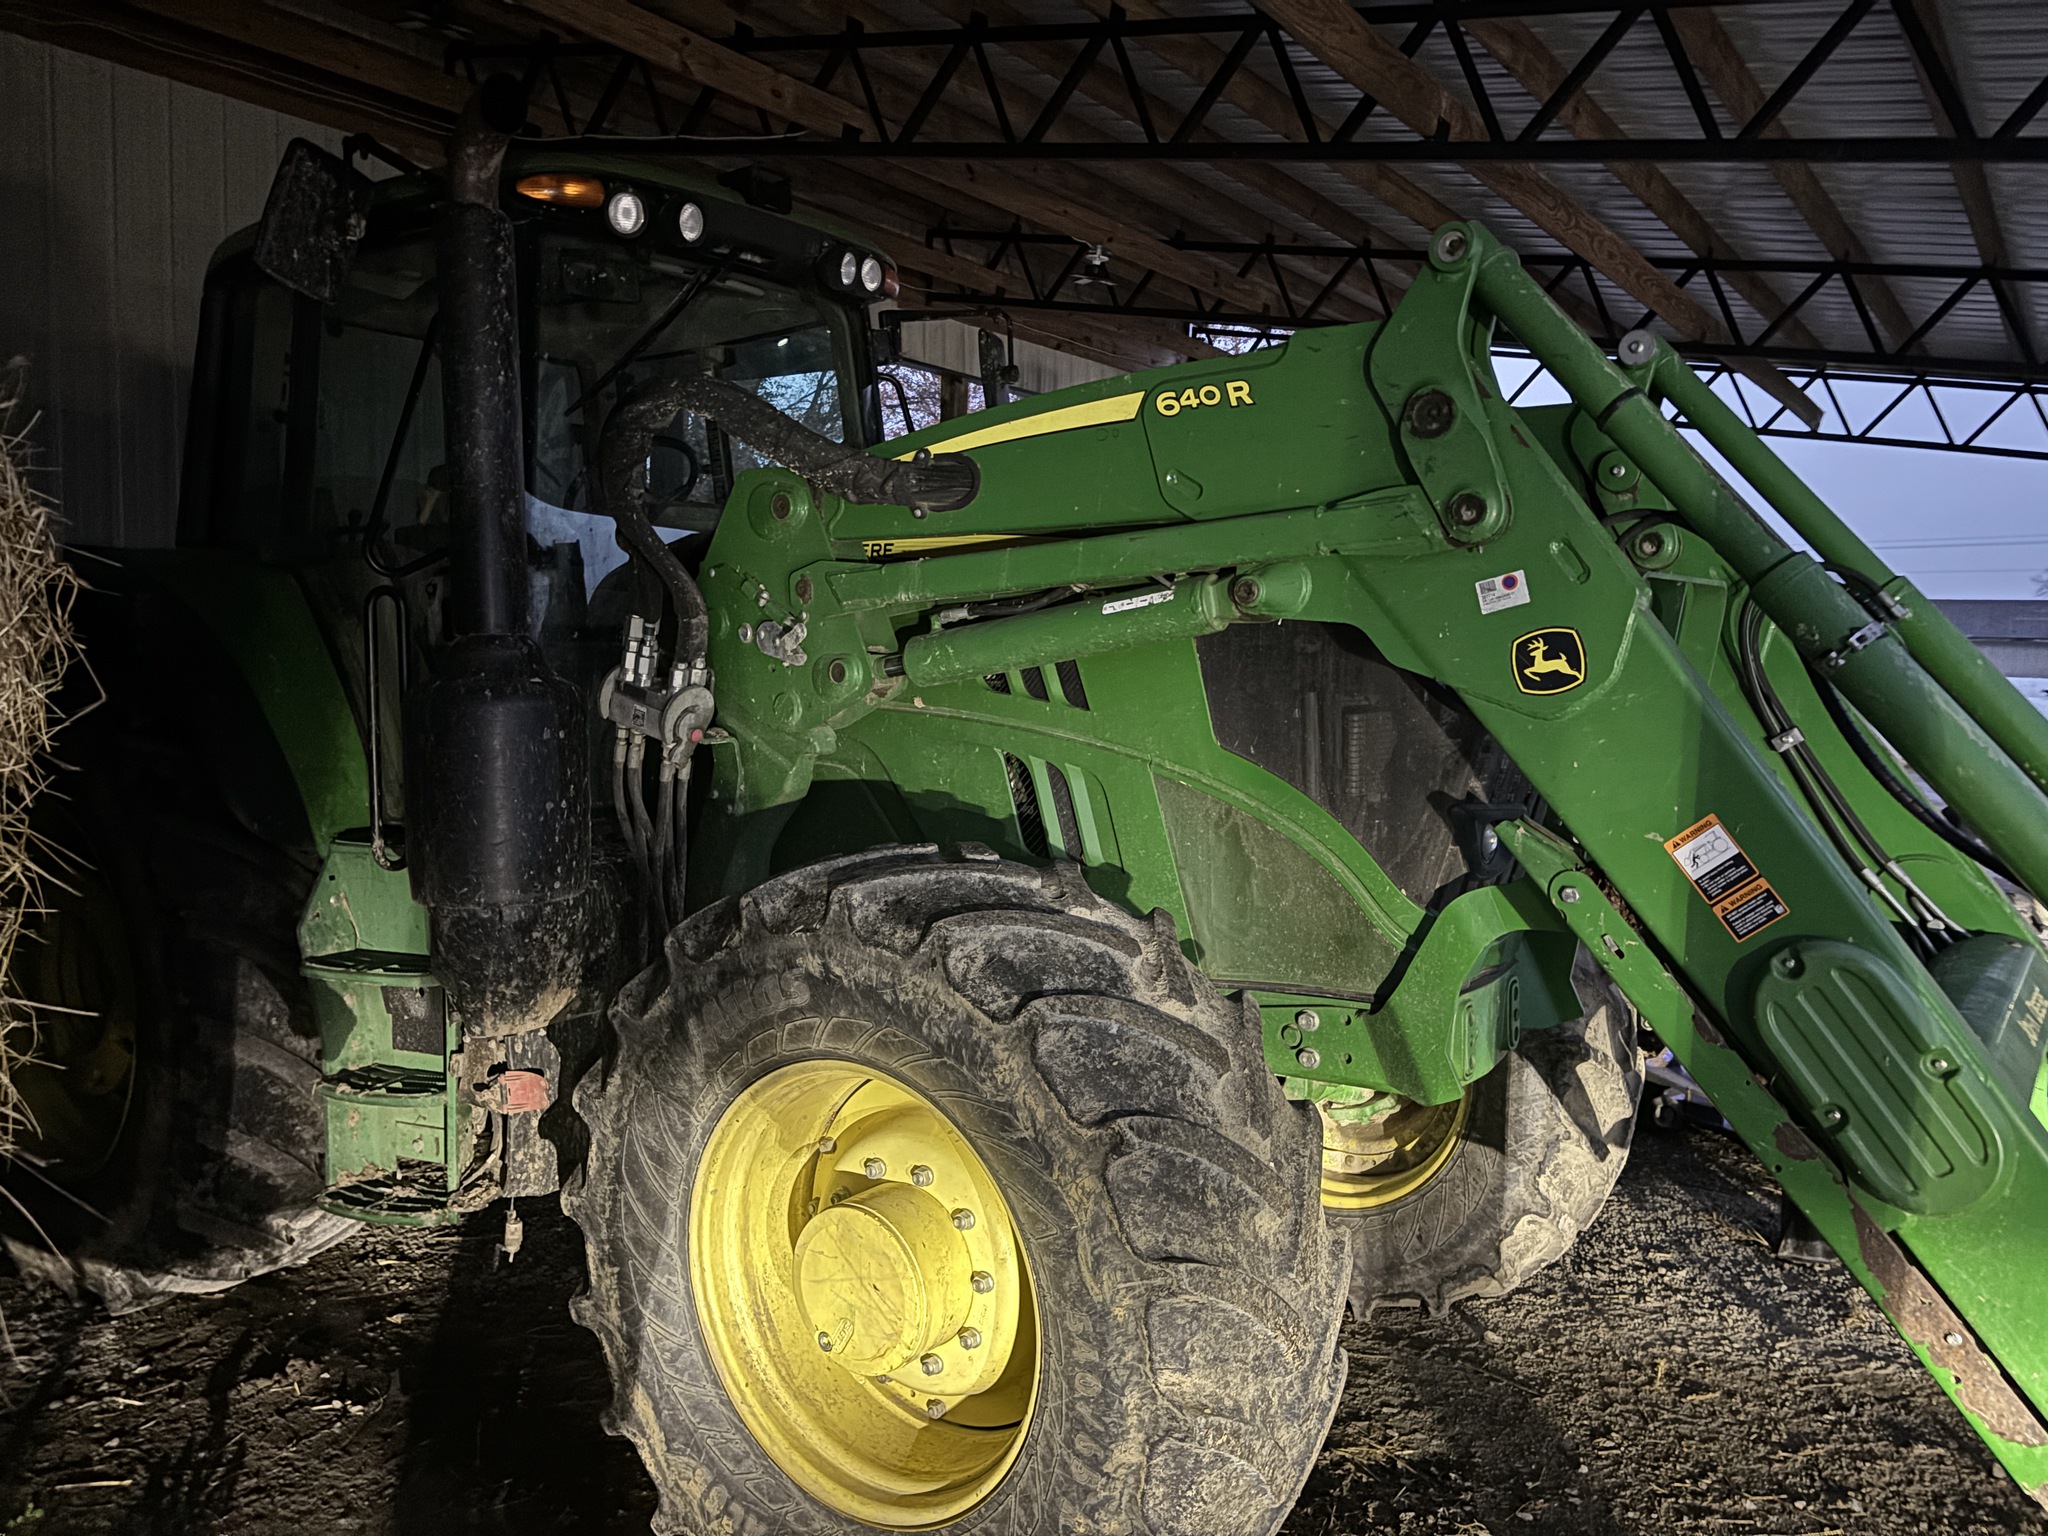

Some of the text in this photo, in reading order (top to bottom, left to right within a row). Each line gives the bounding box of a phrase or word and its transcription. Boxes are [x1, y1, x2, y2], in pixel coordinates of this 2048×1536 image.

[1156, 380, 1256, 416] 640 R
[1679, 820, 1713, 844] WARNING
[1728, 883, 1763, 907] WARNING
